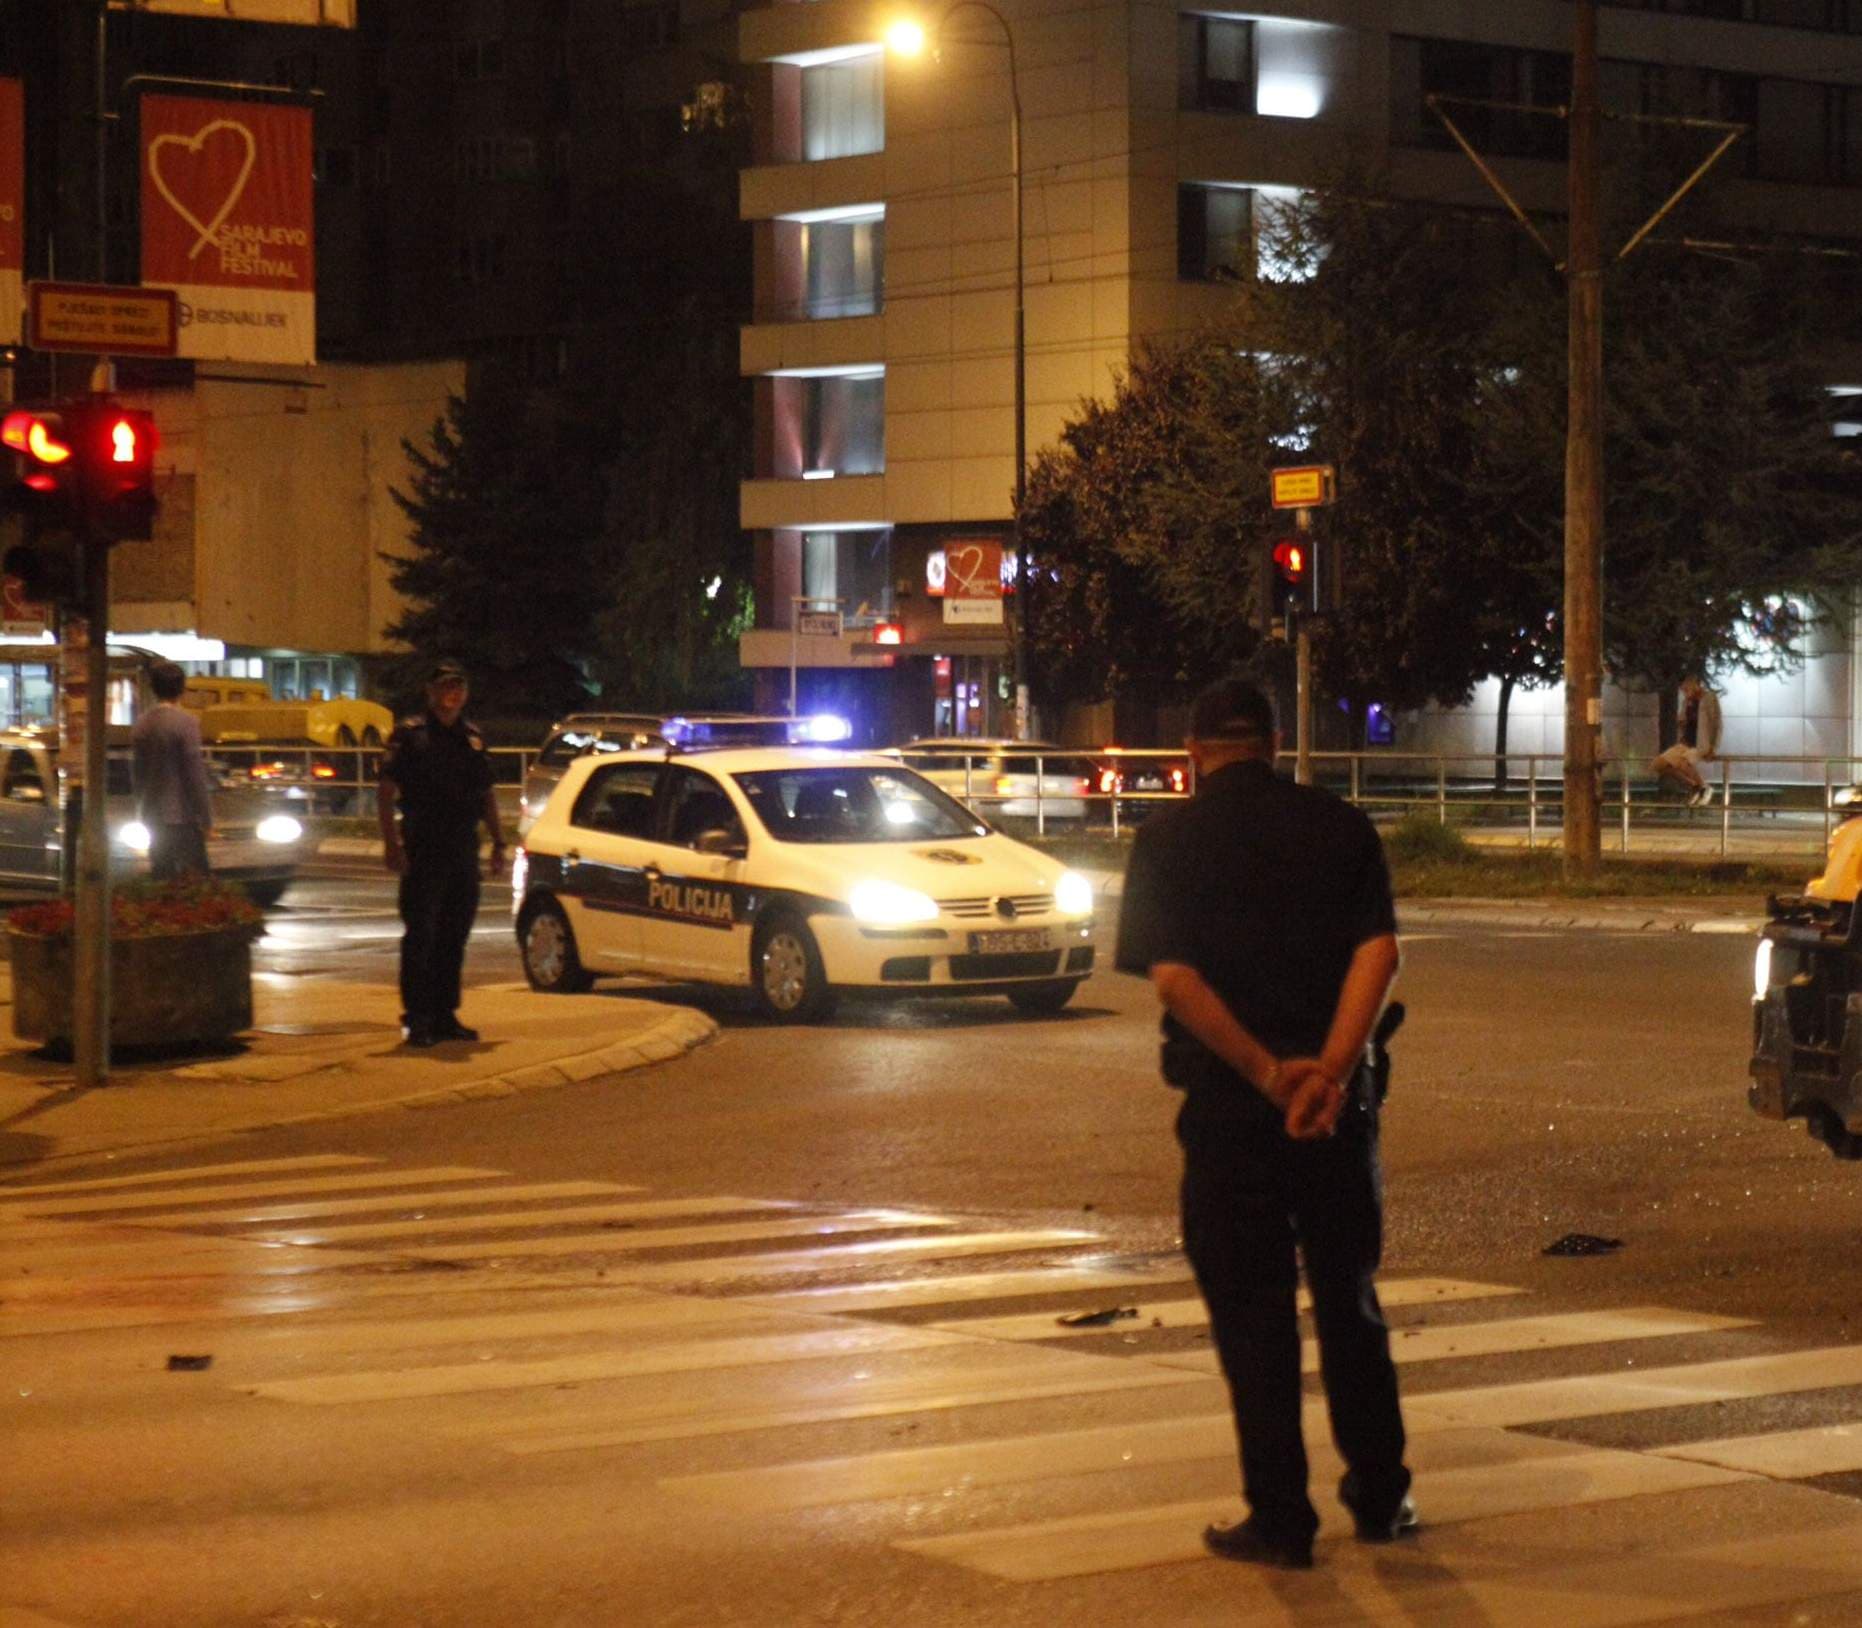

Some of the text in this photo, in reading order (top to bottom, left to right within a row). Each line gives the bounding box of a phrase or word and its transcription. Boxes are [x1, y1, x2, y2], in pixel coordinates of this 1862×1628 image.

[219, 224, 306, 247] SARAJEVO
[220, 257, 299, 279] FESTIVAL
[648, 880, 734, 921] POLICIJA
